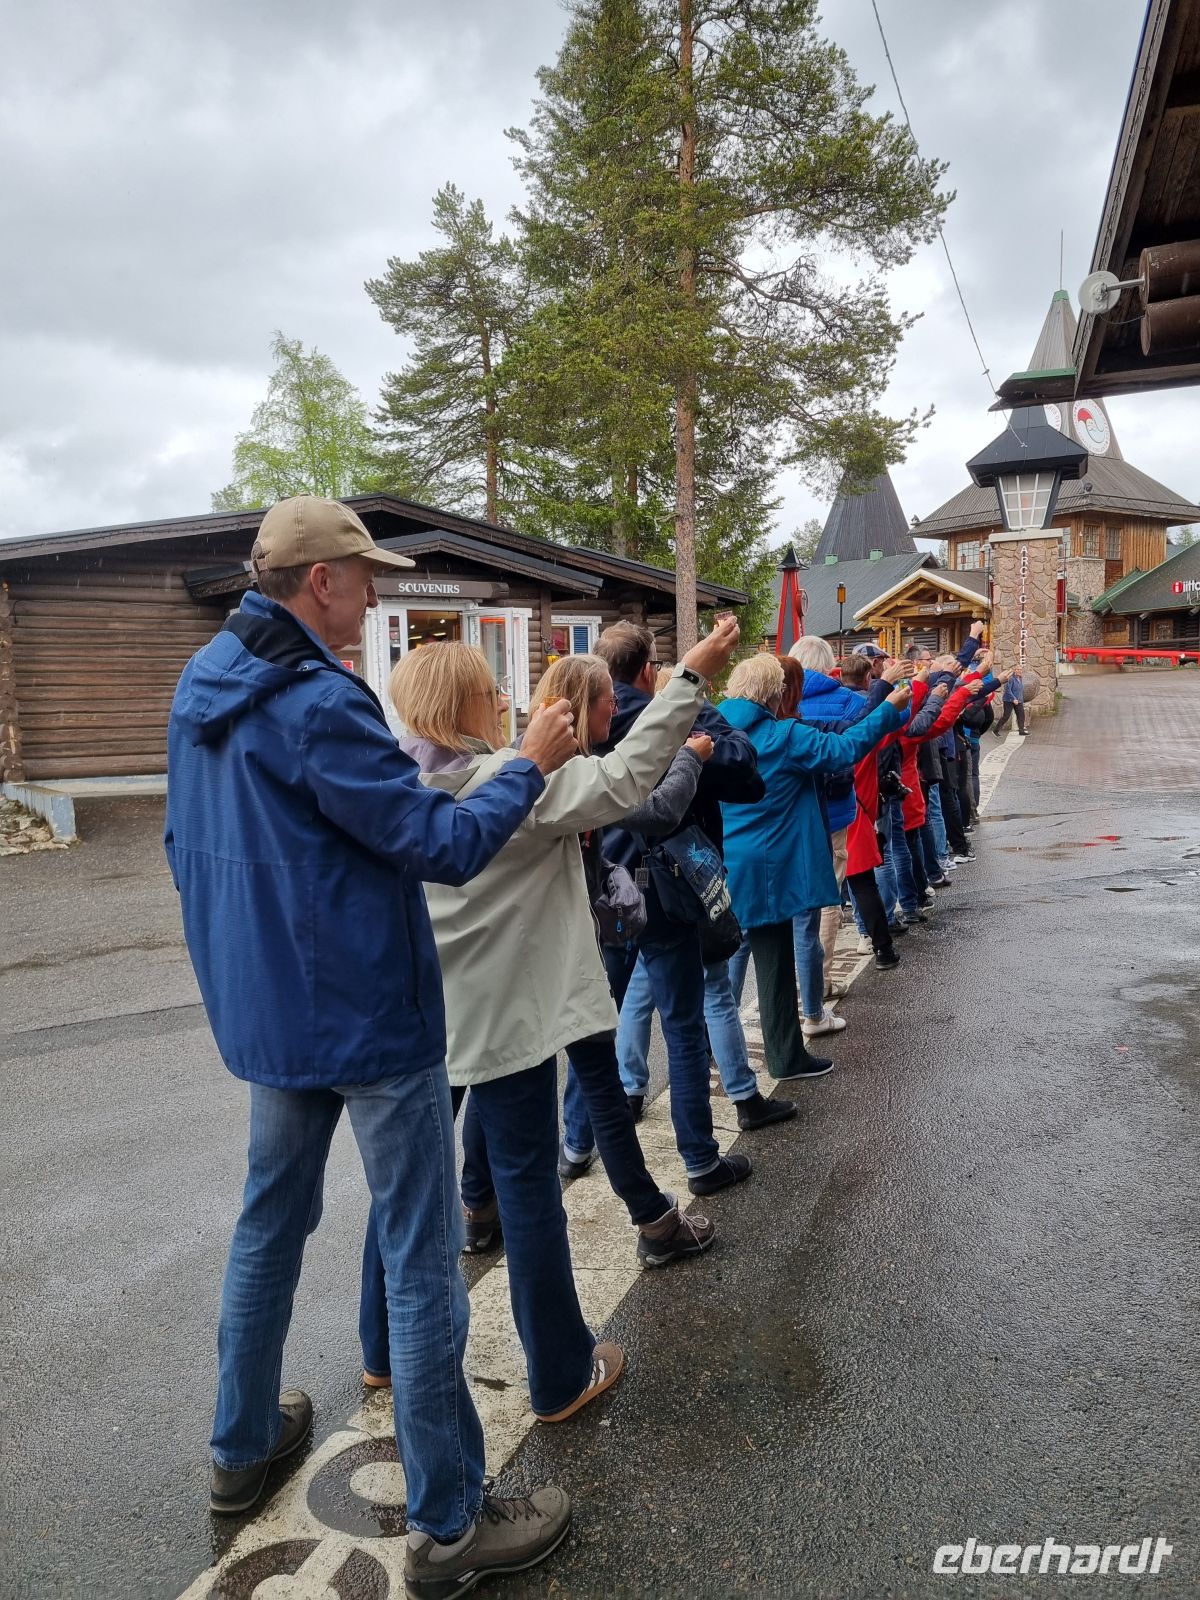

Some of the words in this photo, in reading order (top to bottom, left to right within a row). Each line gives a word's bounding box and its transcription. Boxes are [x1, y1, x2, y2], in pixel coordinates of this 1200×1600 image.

[398, 582, 460, 594] SOUVENIRS
[1019, 545, 1028, 604] ARCTIC
[1019, 612, 1028, 667] CIRCLE
